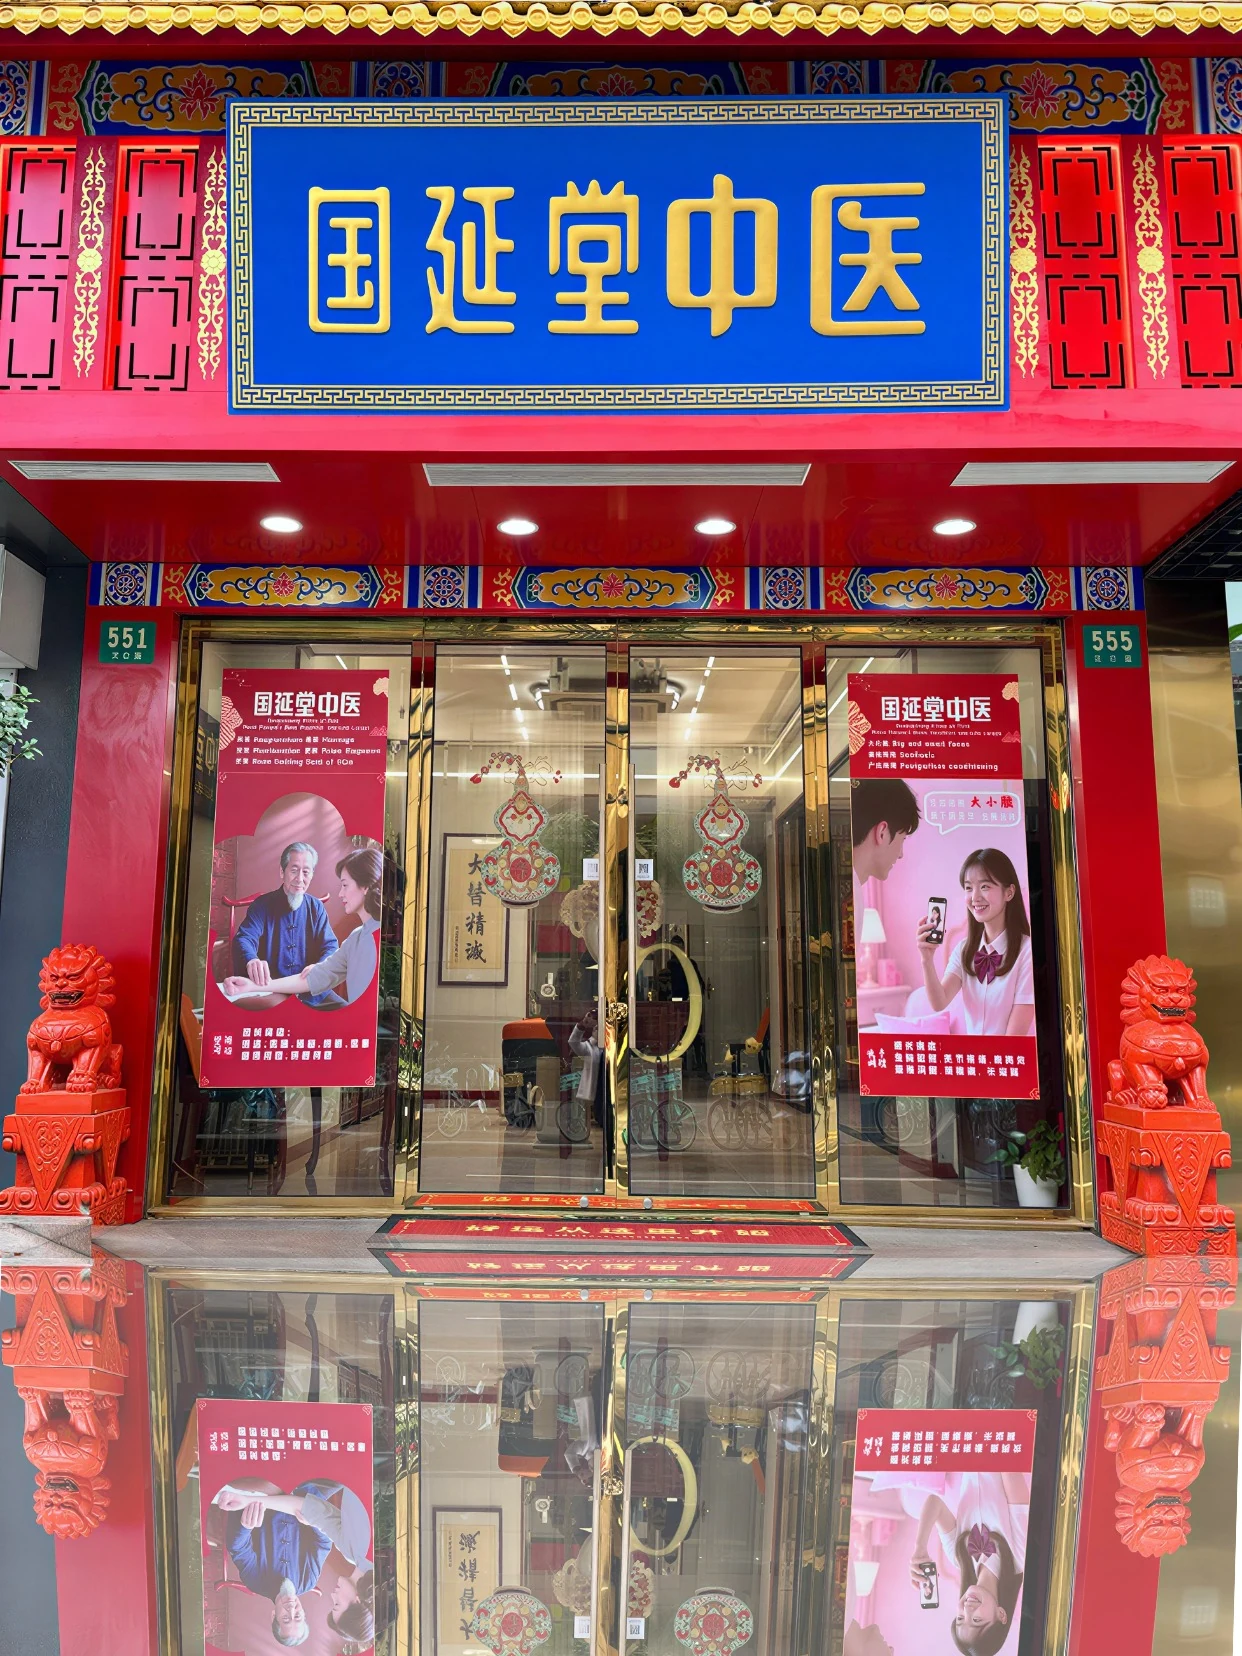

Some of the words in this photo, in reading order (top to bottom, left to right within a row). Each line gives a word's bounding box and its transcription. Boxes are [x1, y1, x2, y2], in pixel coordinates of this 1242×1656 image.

[308, 173, 927, 337] 国延堂中医
[107, 626, 147, 649] 551
[1091, 630, 1133, 651] 555
[254, 690, 361, 717] 国延堂中医
[881, 695, 992, 722] 国延堂中医
